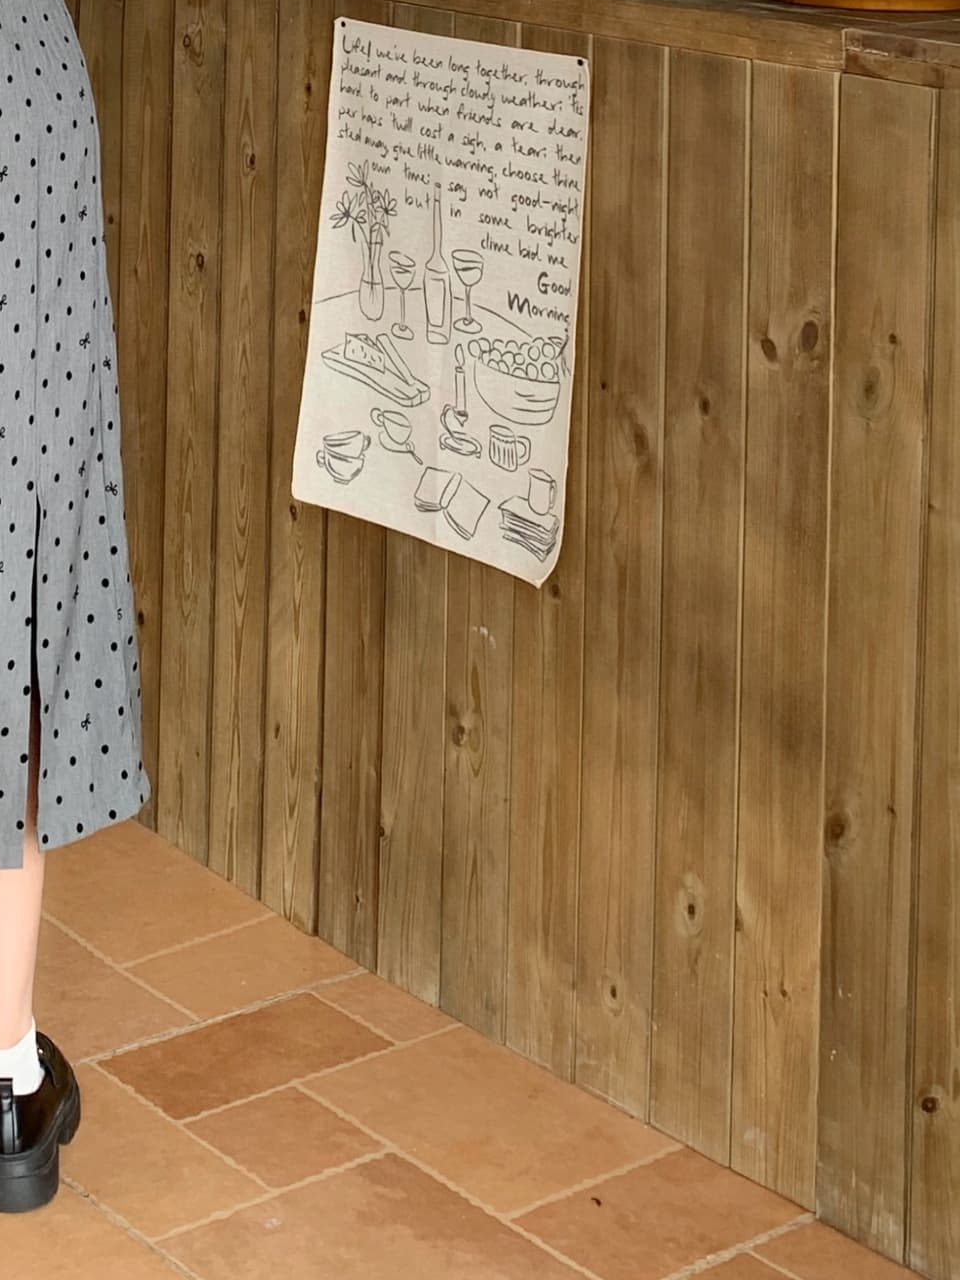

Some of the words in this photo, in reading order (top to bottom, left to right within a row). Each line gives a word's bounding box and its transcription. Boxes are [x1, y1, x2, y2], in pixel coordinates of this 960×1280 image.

[341, 57, 381, 78] pleasant
[412, 71, 457, 101] through
[342, 34, 372, 62] Life!
[376, 45, 407, 63] we've
[413, 48, 443, 68] been
[448, 55, 470, 81] long
[535, 68, 584, 97] through
[340, 78, 363, 98] hard
[369, 84, 379, 102] to
[386, 91, 410, 109] part
[418, 97, 450, 116] when
[456, 102, 501, 128] friends
[511, 120, 538, 133] are
[420, 122, 442, 139] cost
[448, 133, 455, 142] a
[494, 142, 502, 151] a
[555, 143, 581, 165] then
[371, 161, 391, 174] own
[448, 181, 467, 202] say
[479, 183, 499, 199] not
[393, 142, 415, 161] give
[417, 142, 442, 165] little
[502, 160, 548, 185] choose
[552, 168, 581, 192] thine
[405, 188, 430, 210] but
[450, 203, 462, 217] in
[478, 212, 512, 229] some
[526, 213, 579, 247] brighter
[518, 239, 542, 261] bid
[547, 253, 568, 269] me
[537, 271, 572, 297] Good
[507, 289, 570, 334] Morning
